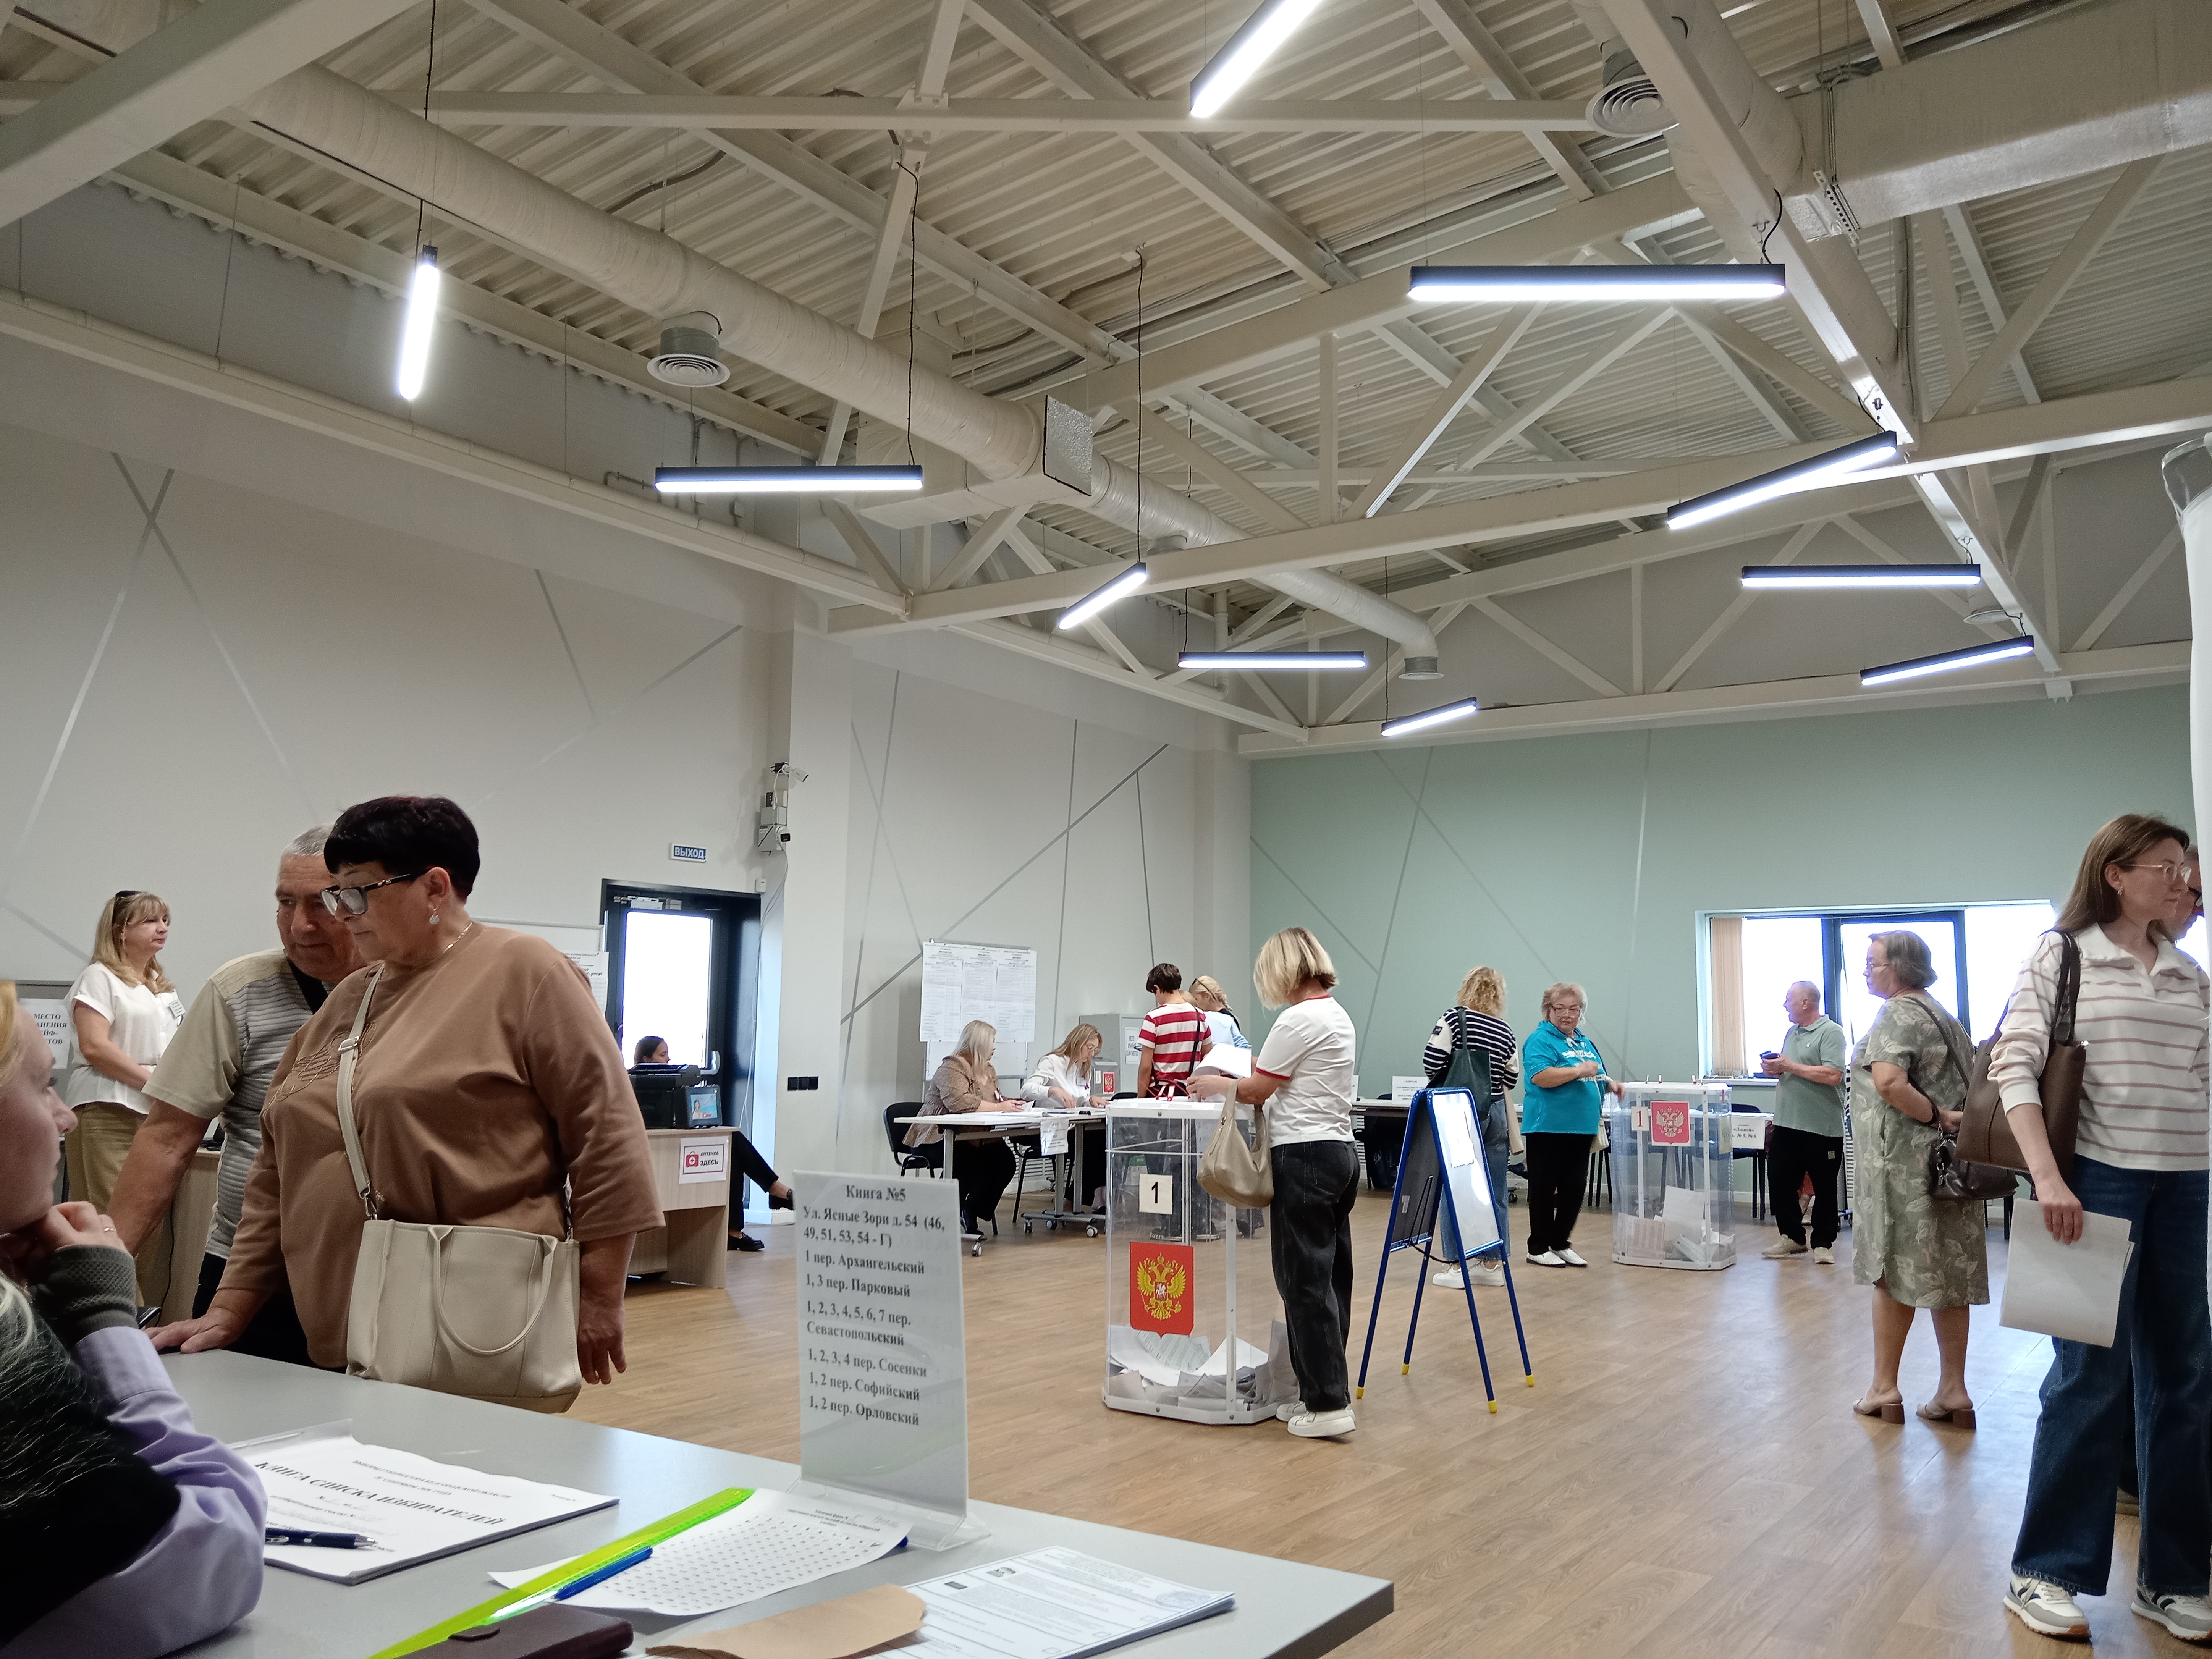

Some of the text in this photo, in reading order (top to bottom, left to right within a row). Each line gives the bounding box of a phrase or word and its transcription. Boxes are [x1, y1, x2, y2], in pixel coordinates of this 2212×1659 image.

[675, 847, 704, 859] ВЫХОД
[1637, 1110, 1643, 1127] 1
[846, 1185, 906, 1202] Книга №5
[1151, 1181, 1158, 1204] 1
[803, 1205, 945, 1232] Ул. Ясные Зори д. 54 (46,
[804, 1226, 819, 1241] 49,
[821, 1228, 837, 1243] 51,
[839, 1229, 855, 1245] 53,
[857, 1231, 870, 1245] 54
[880, 1233, 892, 1249] Г)
[806, 1250, 925, 1274] 1 пер. Архангельский
[807, 1273, 910, 1297] 1, 3 пер. Парковый
[807, 1300, 911, 1328] 1, 2, 3, 4, 5, 6, 7 пер.
[807, 1321, 905, 1346] Севастопольский
[808, 1348, 927, 1377] 1, 2, 3, 4 пер. Сосенки
[810, 1371, 920, 1401] 1, 2 пер. Софийский
[810, 1395, 919, 1426] 1, 2 пер. Орловский
[255, 1462, 310, 1481] КНИГА
[309, 1479, 378, 1499] СПИСКА
[377, 1496, 506, 1525] ИЗБИРАТЕЛЕЙ
